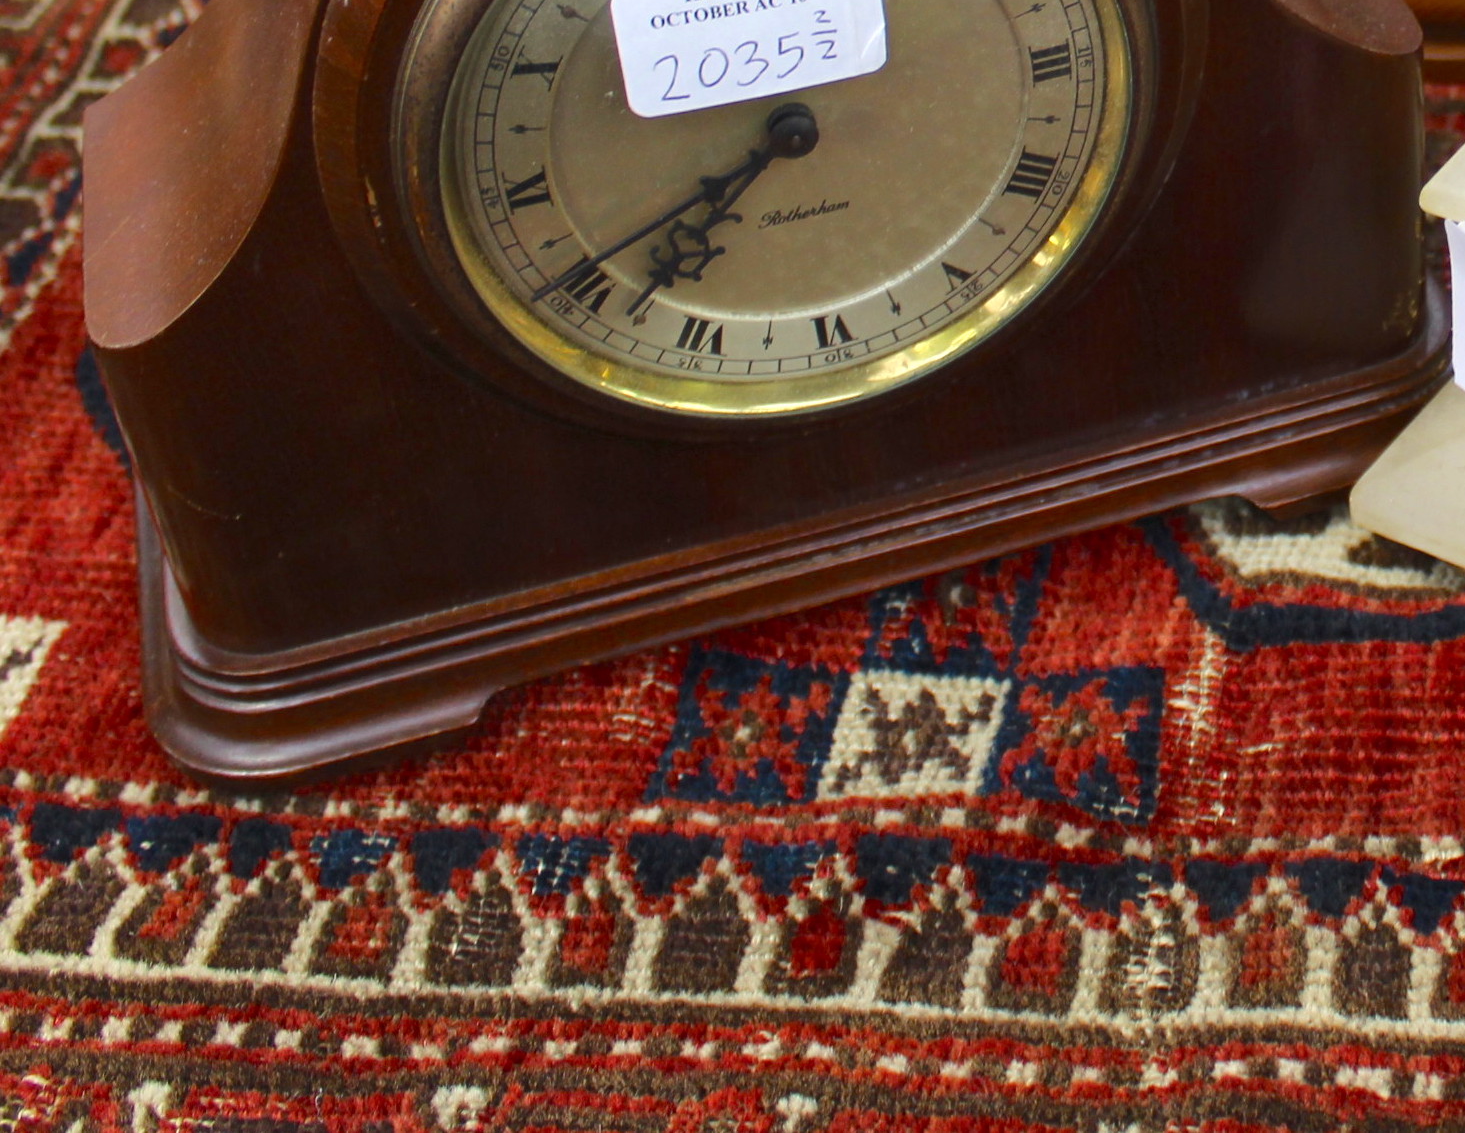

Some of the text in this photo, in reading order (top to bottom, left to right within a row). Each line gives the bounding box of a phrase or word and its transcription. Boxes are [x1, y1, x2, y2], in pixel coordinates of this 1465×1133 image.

[510, 45, 563, 92] X
[652, 32, 805, 101] 2035
[1029, 38, 1072, 88] III
[501, 165, 554, 215] IX
[1001, 145, 1061, 204] IIII
[758, 199, 850, 229] Rotherham
[673, 315, 727, 357] VII
[810, 314, 858, 350] VI
